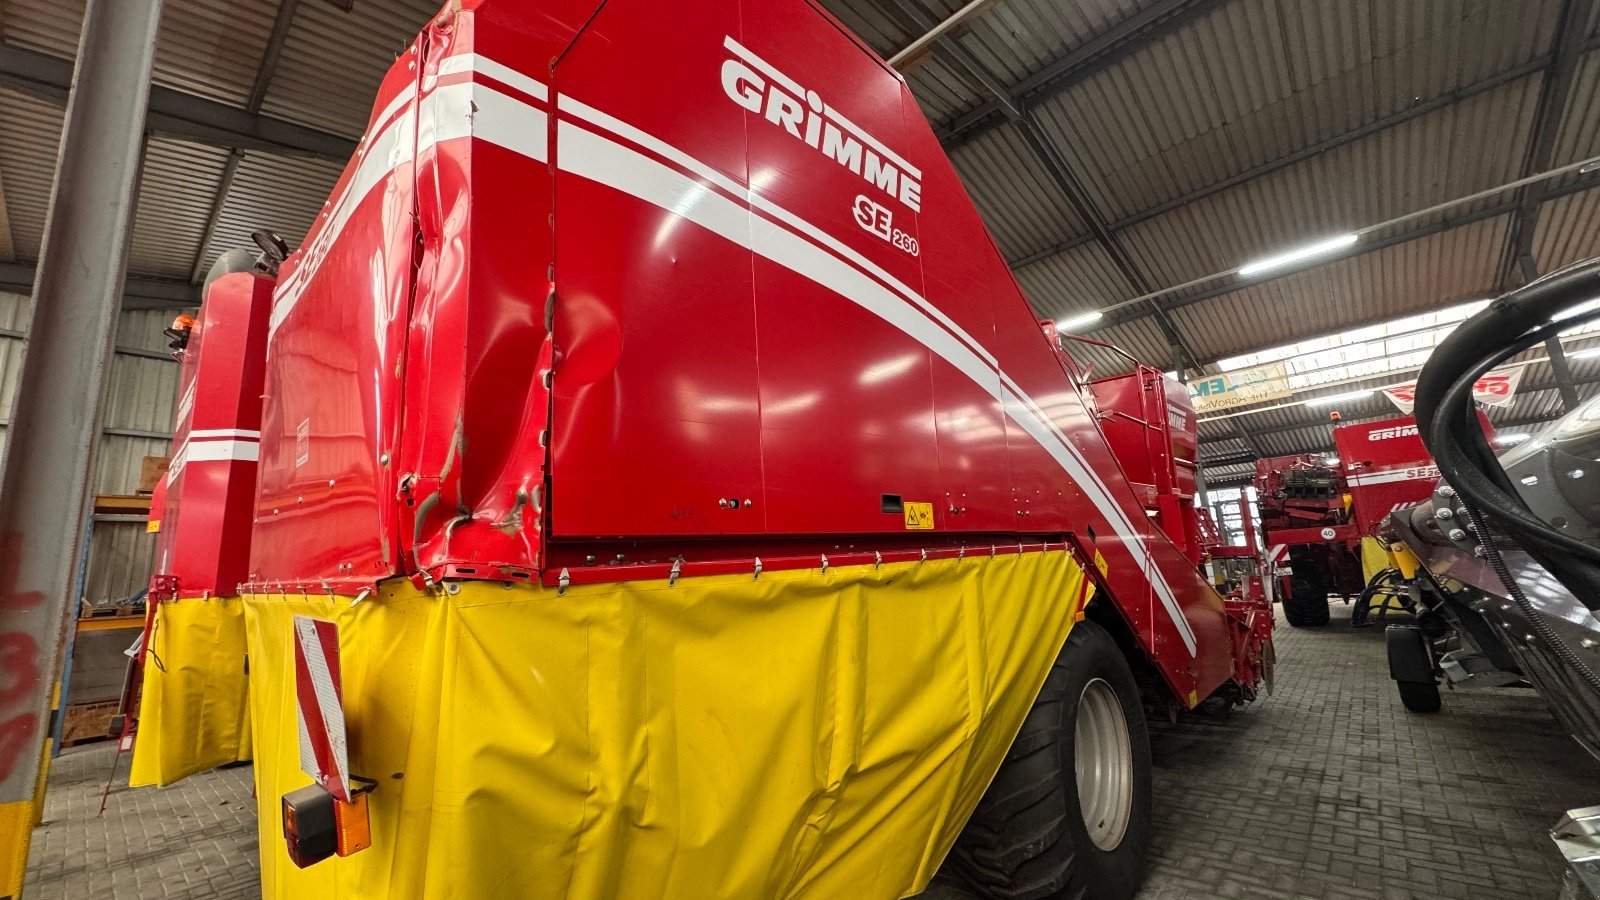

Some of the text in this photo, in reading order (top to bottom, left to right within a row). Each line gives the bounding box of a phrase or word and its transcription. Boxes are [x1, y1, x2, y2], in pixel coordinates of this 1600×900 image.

[721, 59, 921, 213] GRIMME
[852, 194, 919, 257] SE 260
[1368, 426, 1419, 441] GRIM
[1406, 468, 1426, 478] SE
[1322, 529, 1334, 537] 40
